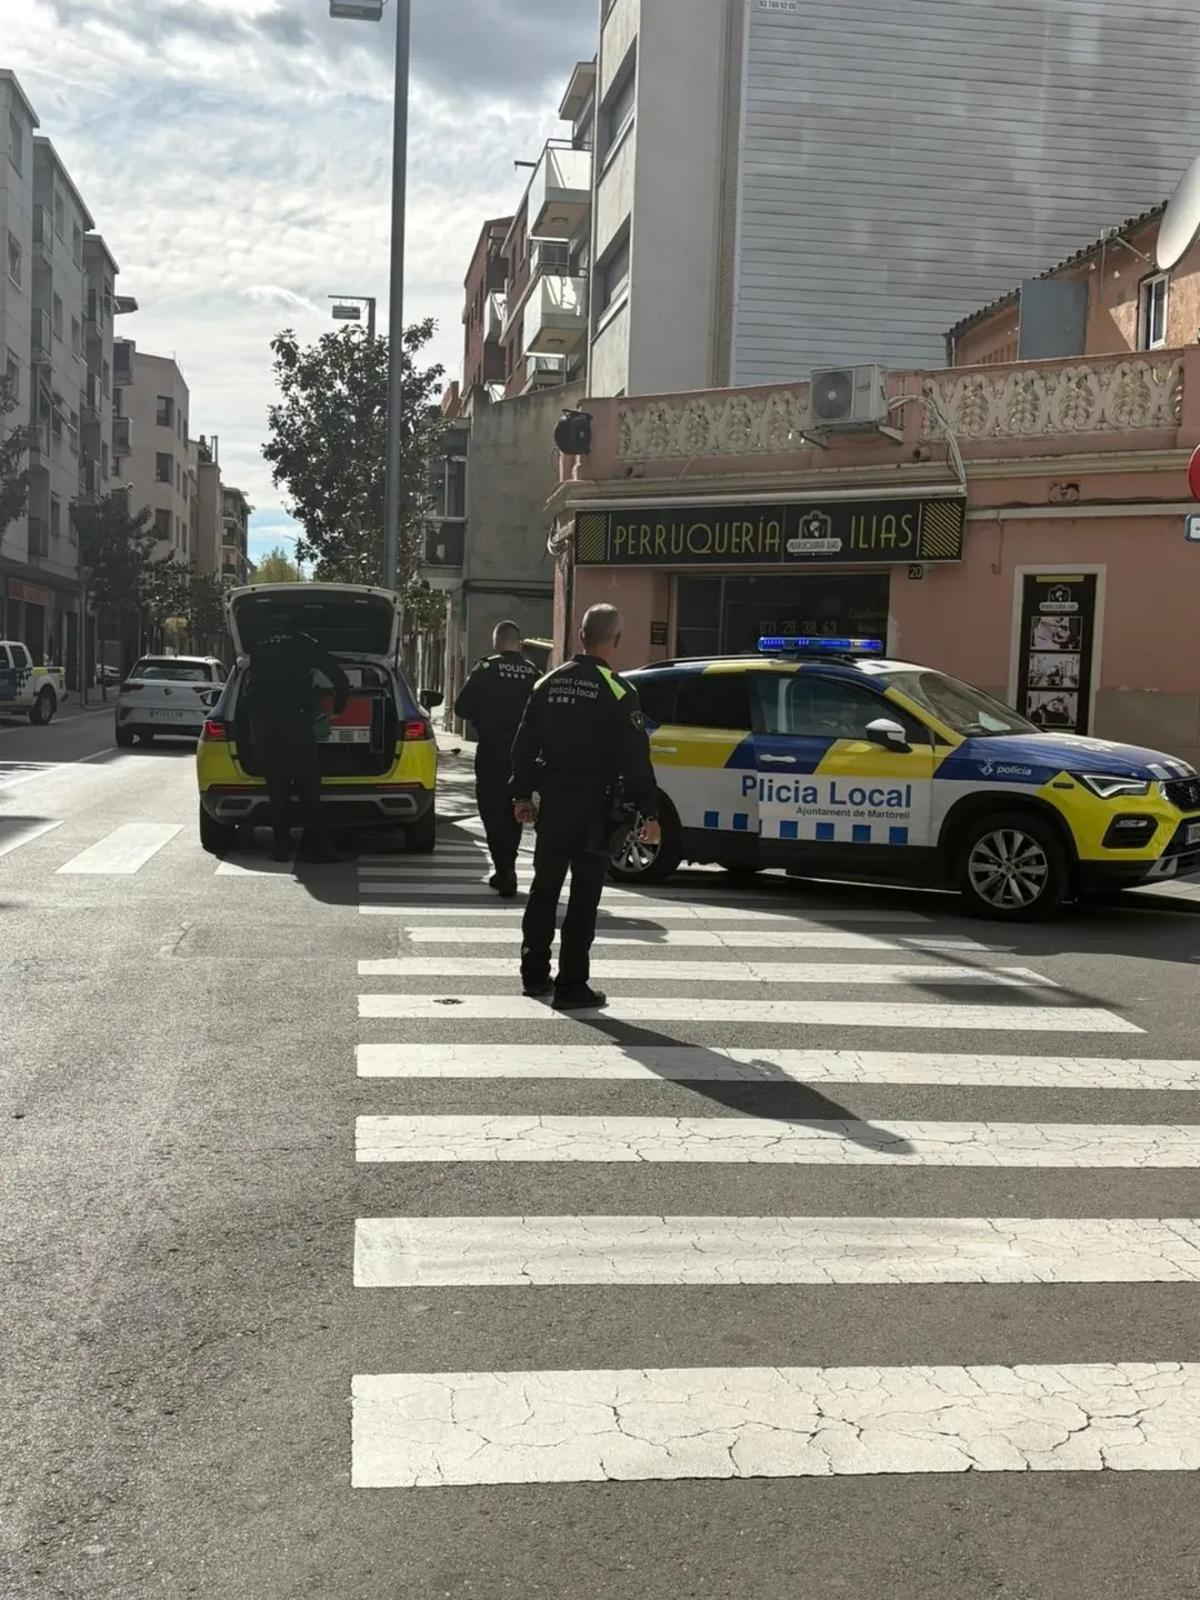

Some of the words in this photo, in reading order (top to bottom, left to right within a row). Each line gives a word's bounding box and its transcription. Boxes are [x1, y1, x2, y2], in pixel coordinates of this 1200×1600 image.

[614, 516, 780, 555] PERRUQUERÍA
[850, 514, 912, 549] ILIAS
[910, 566, 922, 578] 20
[577, 686, 598, 699] local
[829, 781, 912, 808] Local
[796, 806, 850, 817] Ajuntament
[853, 809, 866, 818] de
[868, 809, 911, 820] Martorell
